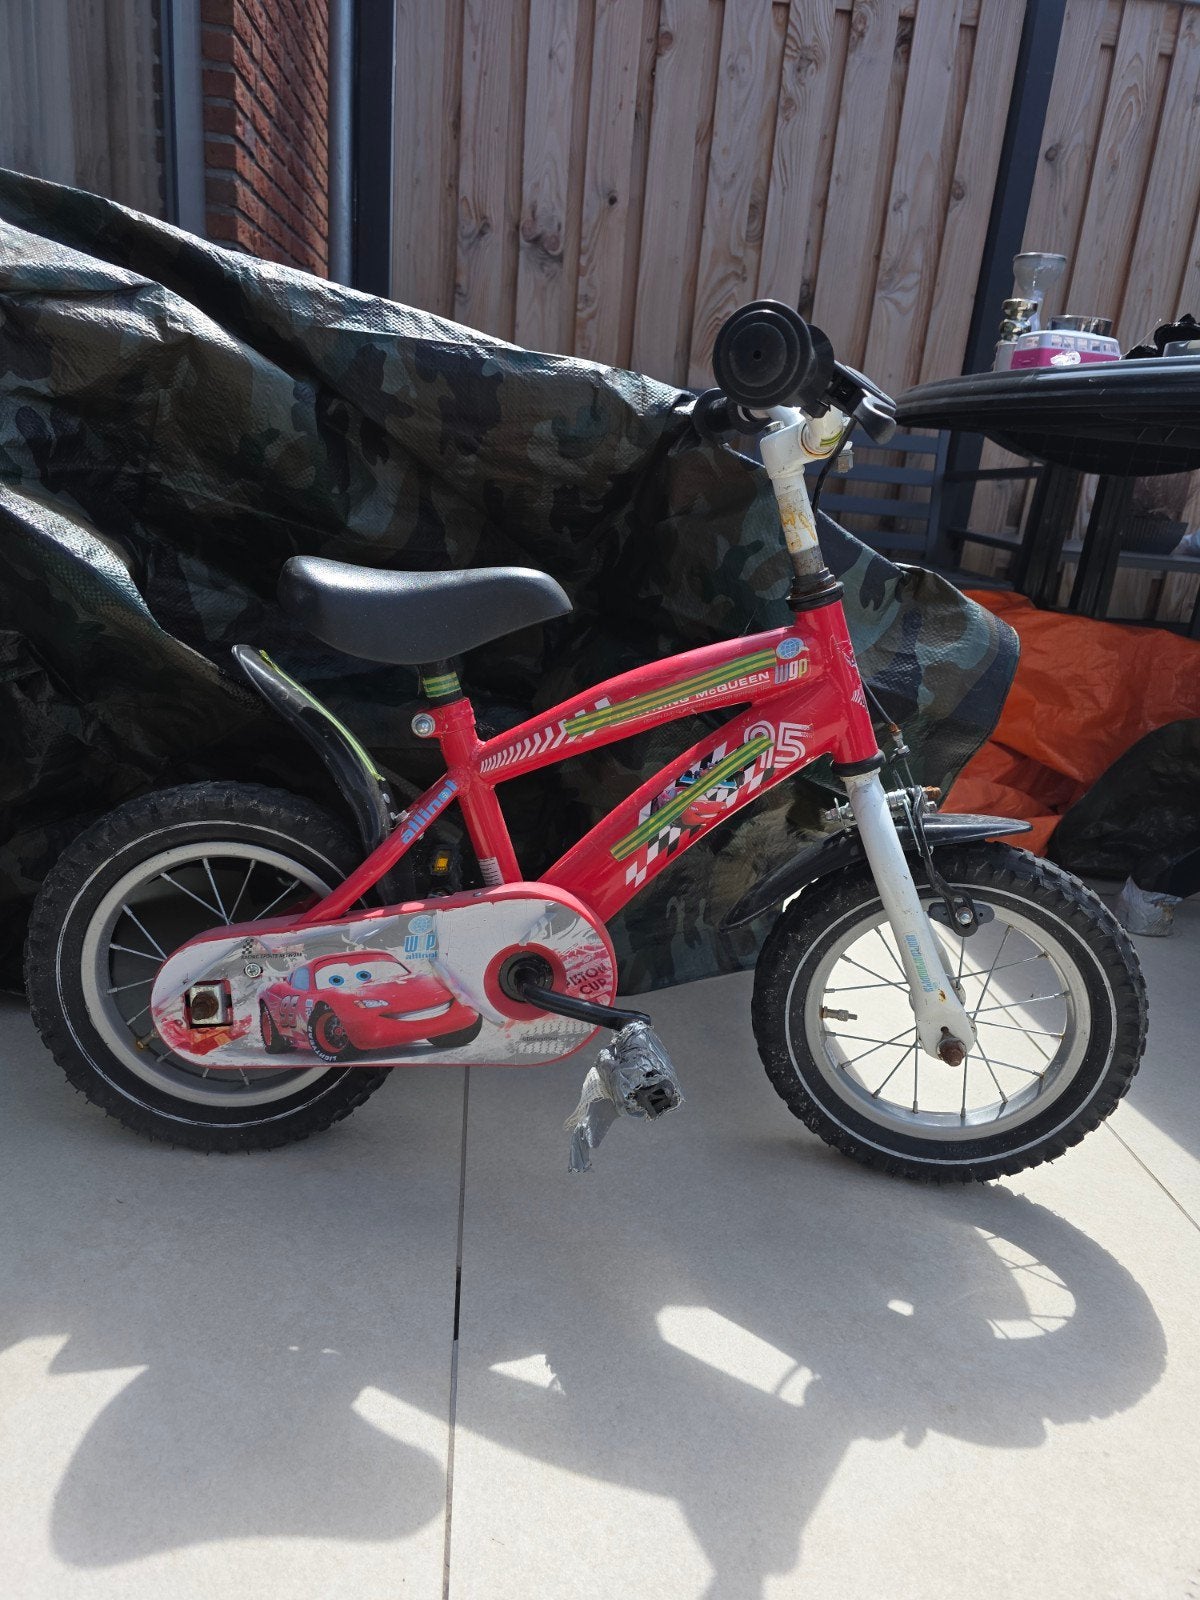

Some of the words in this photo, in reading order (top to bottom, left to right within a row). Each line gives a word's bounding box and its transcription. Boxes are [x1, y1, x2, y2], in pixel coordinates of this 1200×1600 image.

[695, 671, 770, 698] McQUEEN
[743, 720, 812, 768] 95
[566, 962, 607, 986] ISTON
[579, 978, 607, 995] CUP
[280, 995, 300, 1028] 95
